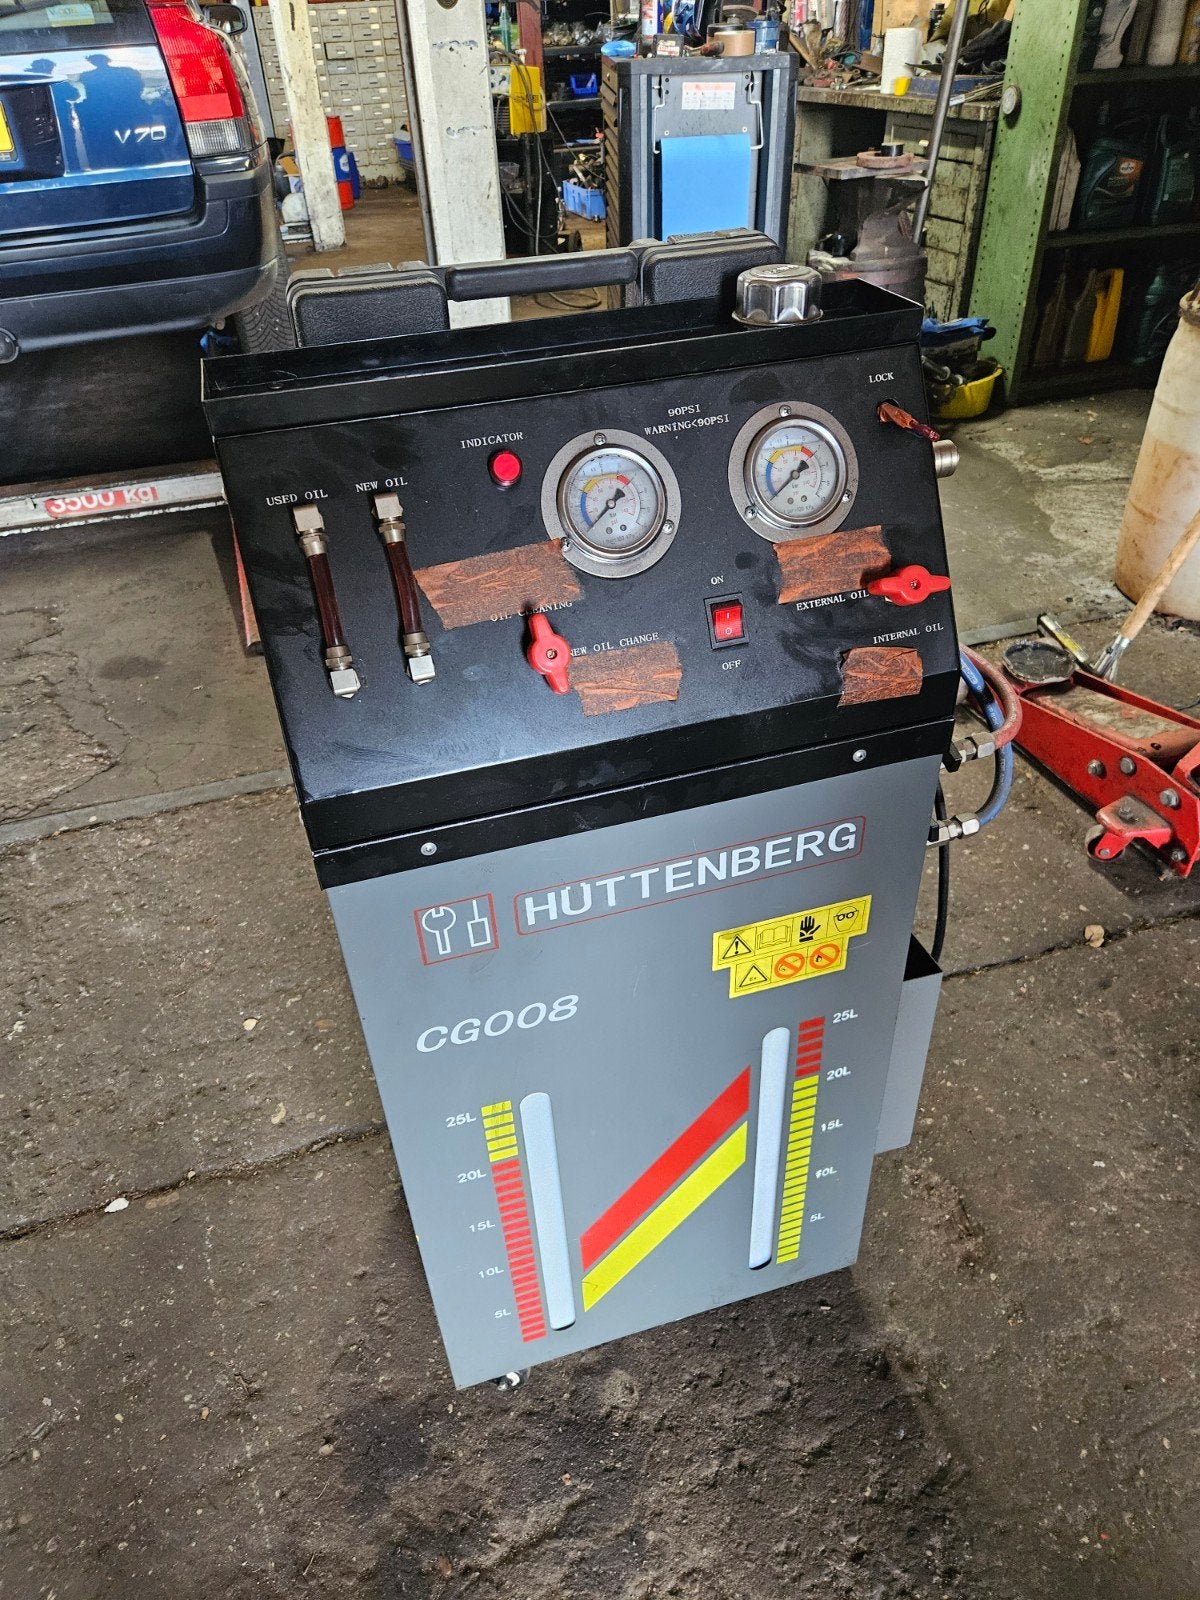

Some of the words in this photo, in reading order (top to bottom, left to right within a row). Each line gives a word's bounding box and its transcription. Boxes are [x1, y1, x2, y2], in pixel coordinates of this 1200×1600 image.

[868, 371, 895, 384] LOCK
[667, 403, 701, 417] 90PSI
[643, 413, 730, 436] WARNING<90PSI
[460, 431, 524, 449] INDICATOR
[355, 480, 378, 493] NEW
[385, 476, 408, 489] OIL
[49, 491, 116, 513] 3500
[265, 493, 298, 506] USED
[304, 488, 329, 501] OIL
[710, 575, 724, 585] ON
[796, 595, 846, 612] EXTERNAL
[850, 589, 869, 600] OIL
[872, 627, 921, 644] INTERNAL
[925, 622, 944, 633] OIL
[593, 641, 614, 652] OIL
[619, 632, 660, 647] CHANGE
[721, 659, 742, 671] OFF
[416, 994, 579, 1054] CG008
[832, 1009, 858, 1024] 25L
[826, 1066, 851, 1081] 20L
[446, 1112, 477, 1128] 25L
[821, 1119, 844, 1132] 15L
[457, 1168, 486, 1184] 20L
[815, 1167, 837, 1178] 10L
[809, 1213, 825, 1223] 5L
[469, 1220, 496, 1233] 15L
[478, 1266, 504, 1279] 10L
[494, 1308, 512, 1320] 5L
